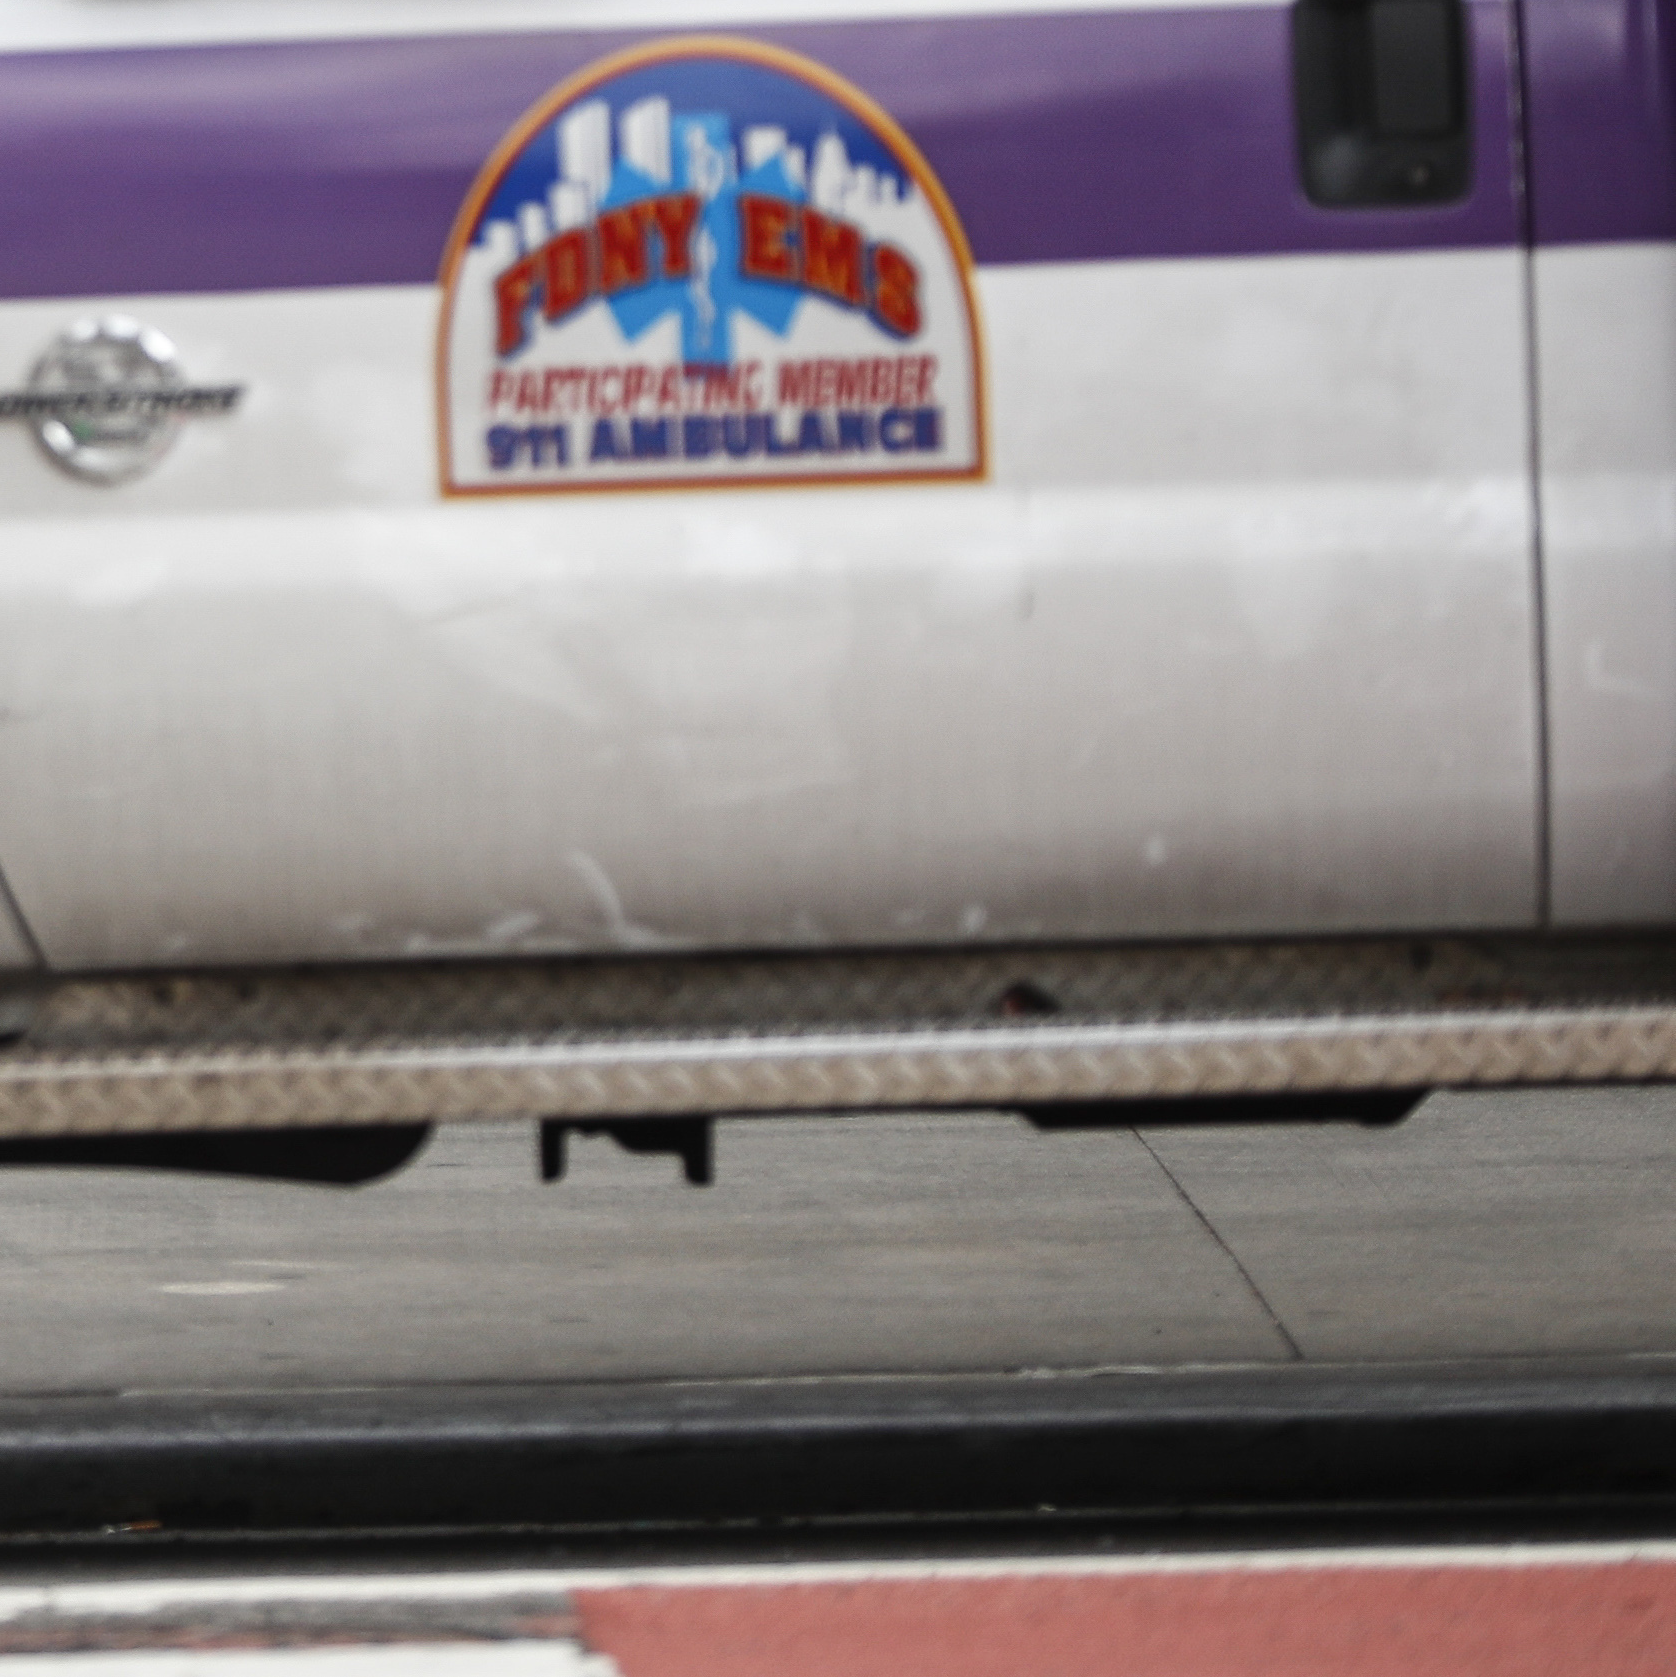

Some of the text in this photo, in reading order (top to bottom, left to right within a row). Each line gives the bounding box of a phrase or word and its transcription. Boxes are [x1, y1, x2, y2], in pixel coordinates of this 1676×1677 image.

[493, 190, 922, 361] FDNY EMS
[487, 354, 940, 414] PARTICIPATING MEMBER
[485, 407, 943, 471] 911 AMBULANCE
